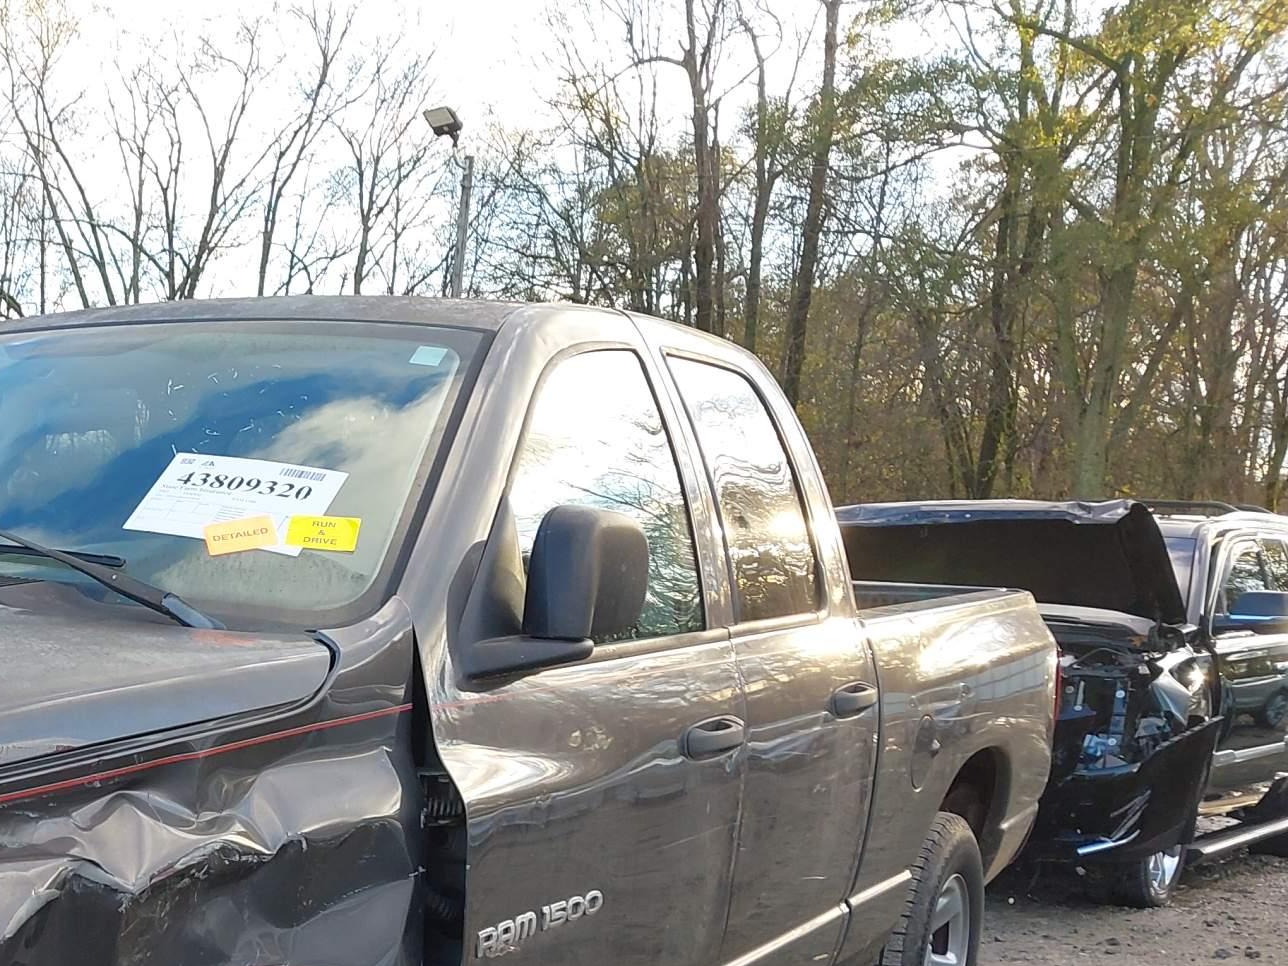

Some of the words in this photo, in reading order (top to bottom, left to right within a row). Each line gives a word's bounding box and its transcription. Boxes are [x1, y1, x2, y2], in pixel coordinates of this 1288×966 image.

[176, 471, 313, 501] 43809320
[312, 519, 337, 529] RUN
[212, 526, 269, 542] DETAILED
[303, 536, 337, 546] DRIVE
[475, 911, 537, 958] RAM
[541, 889, 604, 931] 1500
